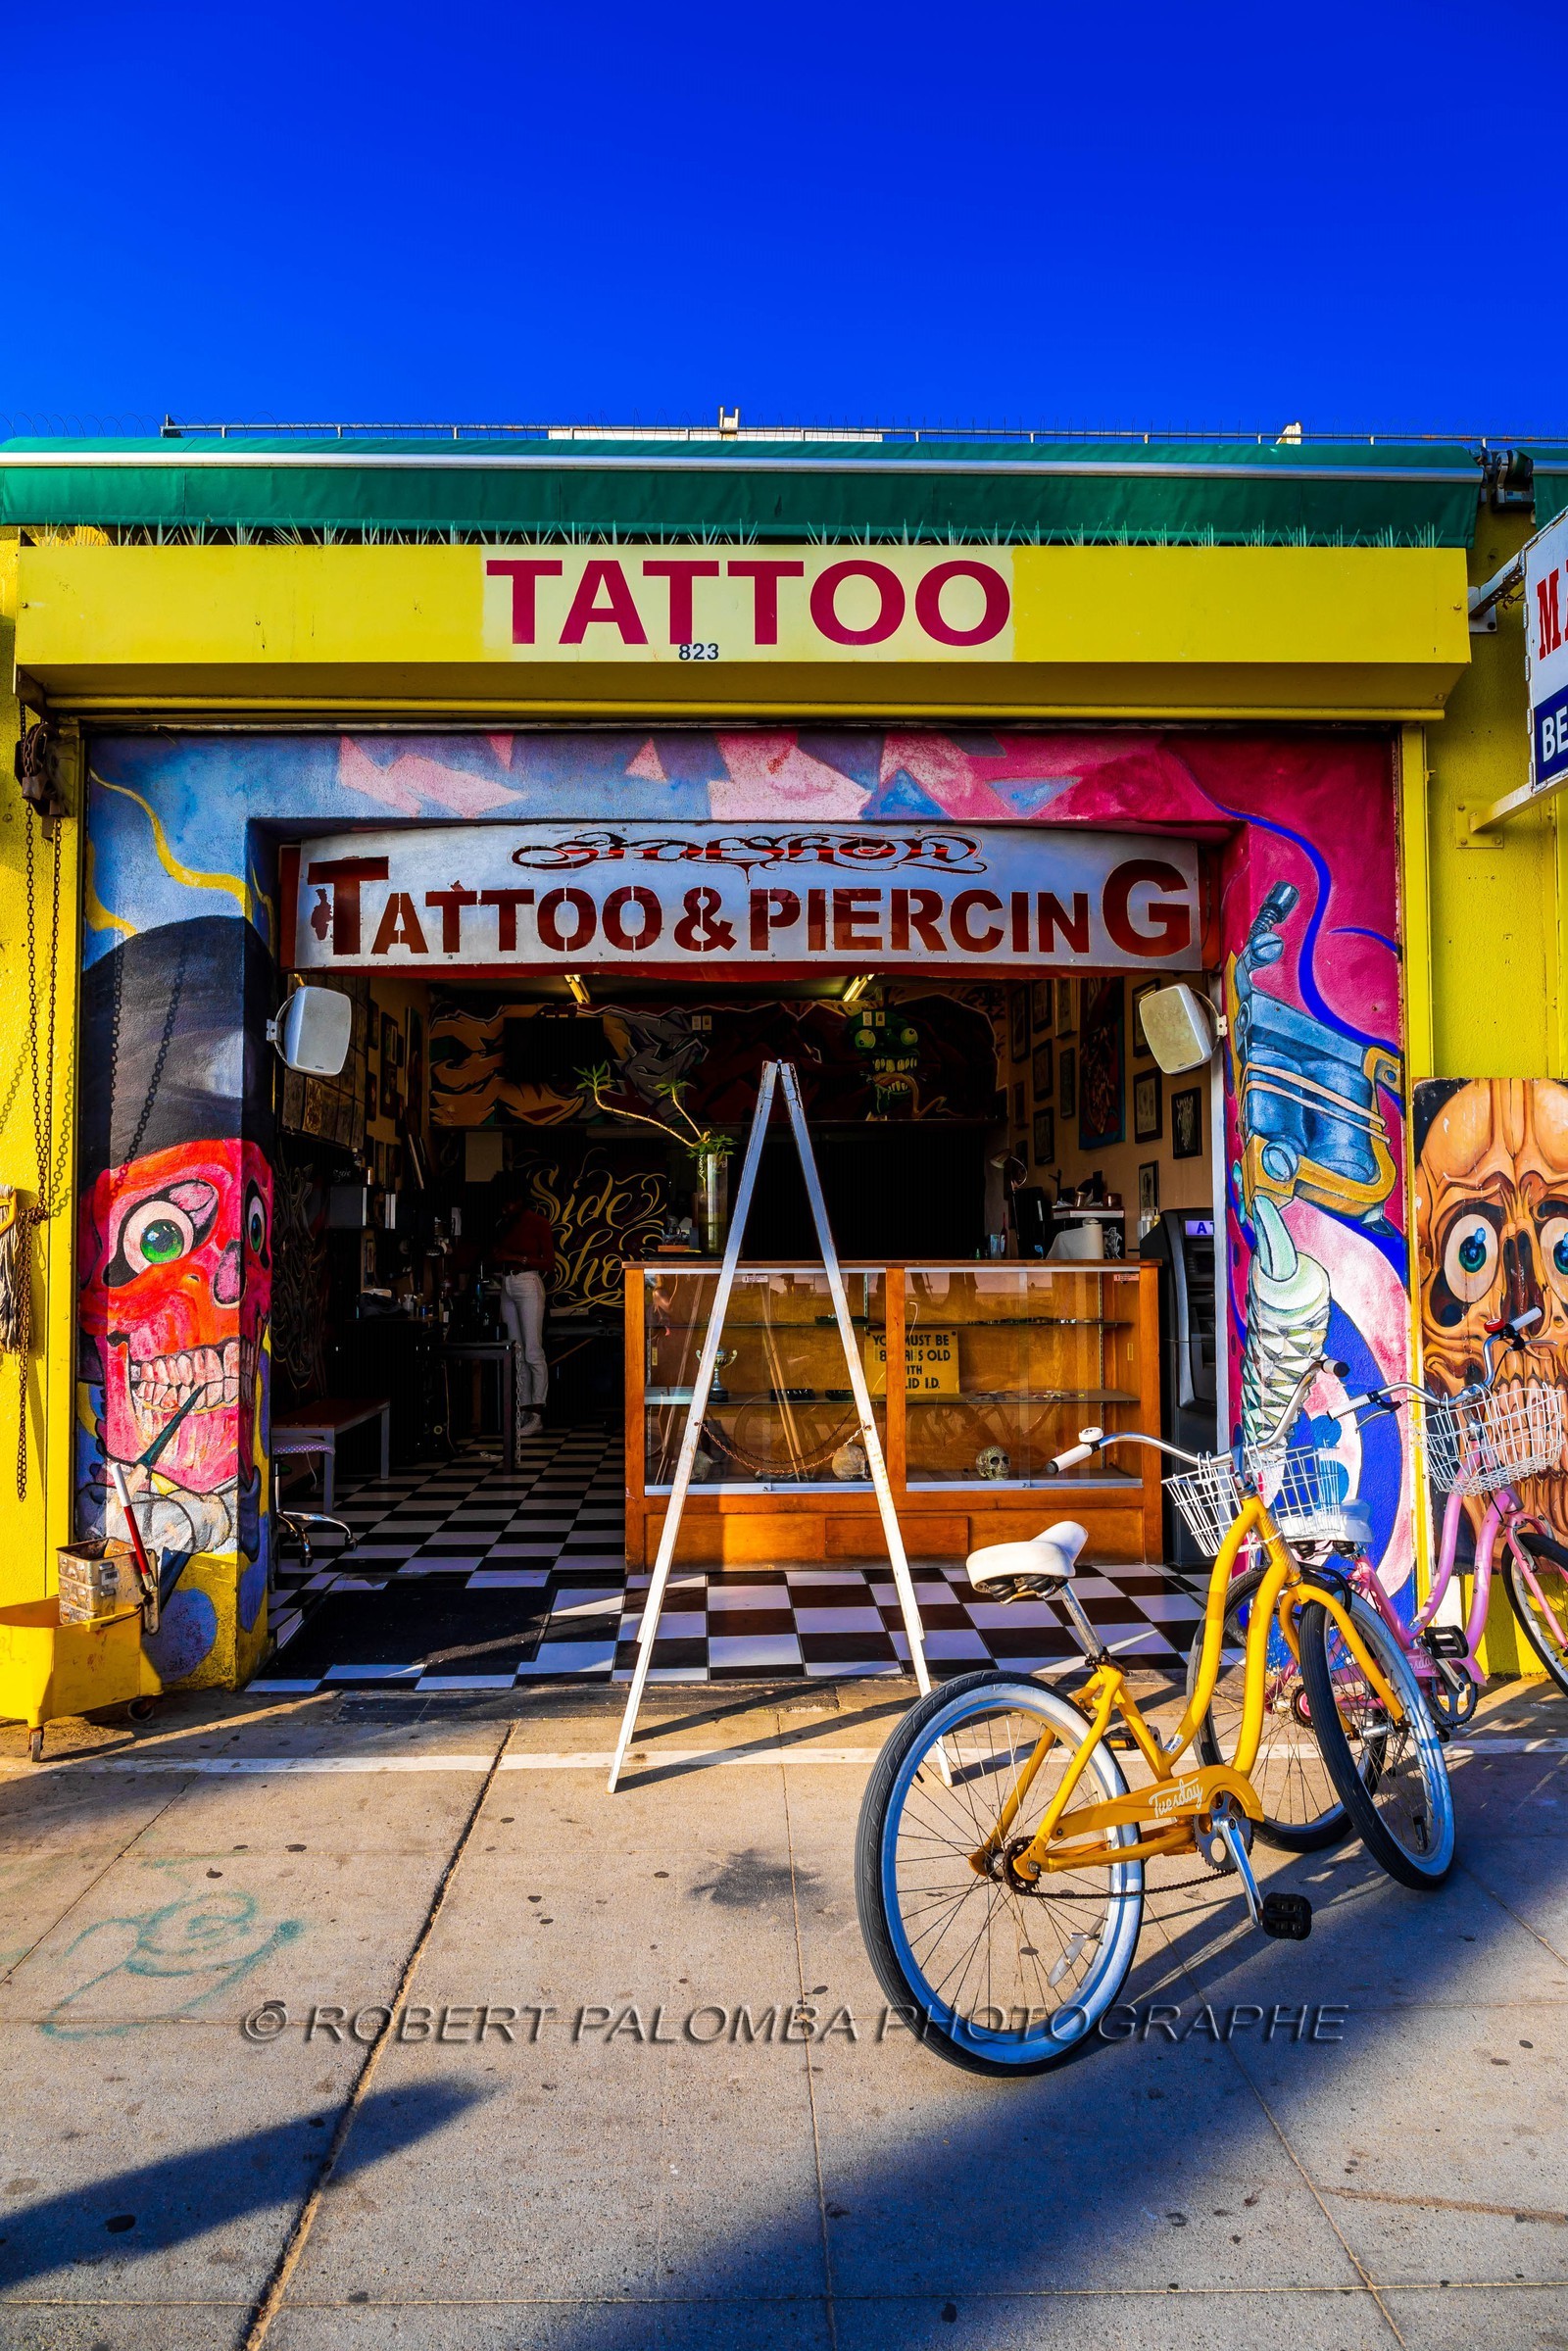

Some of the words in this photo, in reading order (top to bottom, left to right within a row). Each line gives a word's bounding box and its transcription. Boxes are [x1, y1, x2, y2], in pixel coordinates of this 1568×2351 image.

[486, 560, 1011, 647] TATTOO
[1537, 559, 1568, 661] M
[678, 643, 720, 661] 823
[307, 856, 663, 955] TATTOO
[673, 886, 738, 953] &
[750, 858, 1192, 957] PIERCING
[527, 1156, 642, 1230] Side
[1196, 1221, 1214, 1235] A
[549, 1224, 629, 1293] Sho
[872, 1334, 887, 1347] YO
[935, 1334, 950, 1347] BE
[926, 1349, 951, 1362] OLD
[905, 1364, 923, 1375] ITH
[924, 1377, 941, 1390] I.D.
[1148, 1777, 1204, 1819] Tuesday
